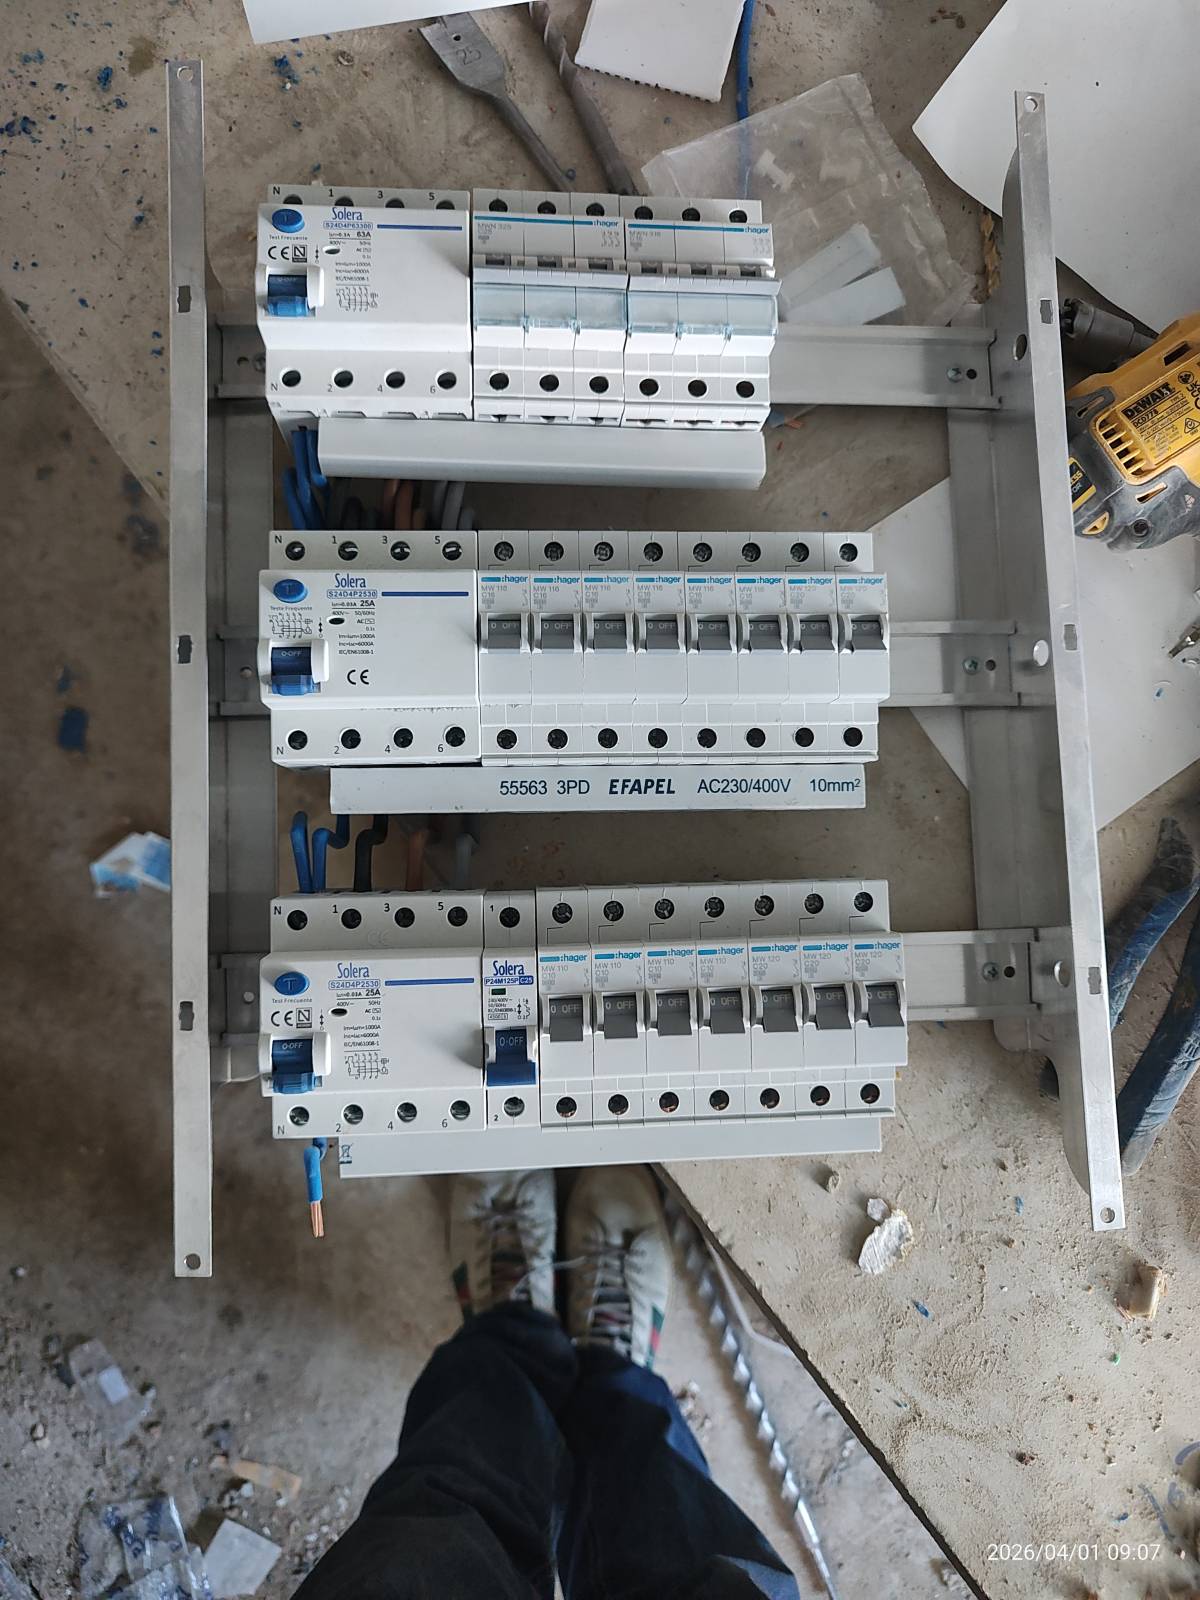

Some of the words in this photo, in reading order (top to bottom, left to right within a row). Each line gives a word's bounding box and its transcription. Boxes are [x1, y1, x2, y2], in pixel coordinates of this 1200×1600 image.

[378, 191, 384, 199] 3
[332, 207, 362, 220] Solera
[268, 246, 290, 260] CE
[275, 536, 282, 544] N
[332, 536, 337, 544] 1
[382, 536, 388, 544] 3
[435, 536, 440, 544] 5
[335, 573, 366, 588] Solera
[347, 669, 369, 685] CE
[334, 746, 340, 754] 2
[385, 745, 390, 753] 4
[438, 744, 444, 752] 6
[500, 780, 548, 796] 55563
[556, 779, 590, 796] 3PD
[608, 778, 676, 795] EFAPEL
[697, 778, 791, 794] AC230/400V
[332, 905, 338, 913] 1
[384, 904, 390, 912] 3
[438, 902, 444, 910] 5
[274, 906, 282, 915] N
[337, 962, 370, 979] Solera
[492, 960, 525, 976] Solera
[271, 1010, 293, 1027] CE
[335, 1123, 342, 1132] 2
[387, 1121, 394, 1130] 4
[442, 1119, 448, 1128] 6
[278, 1126, 285, 1134] N
